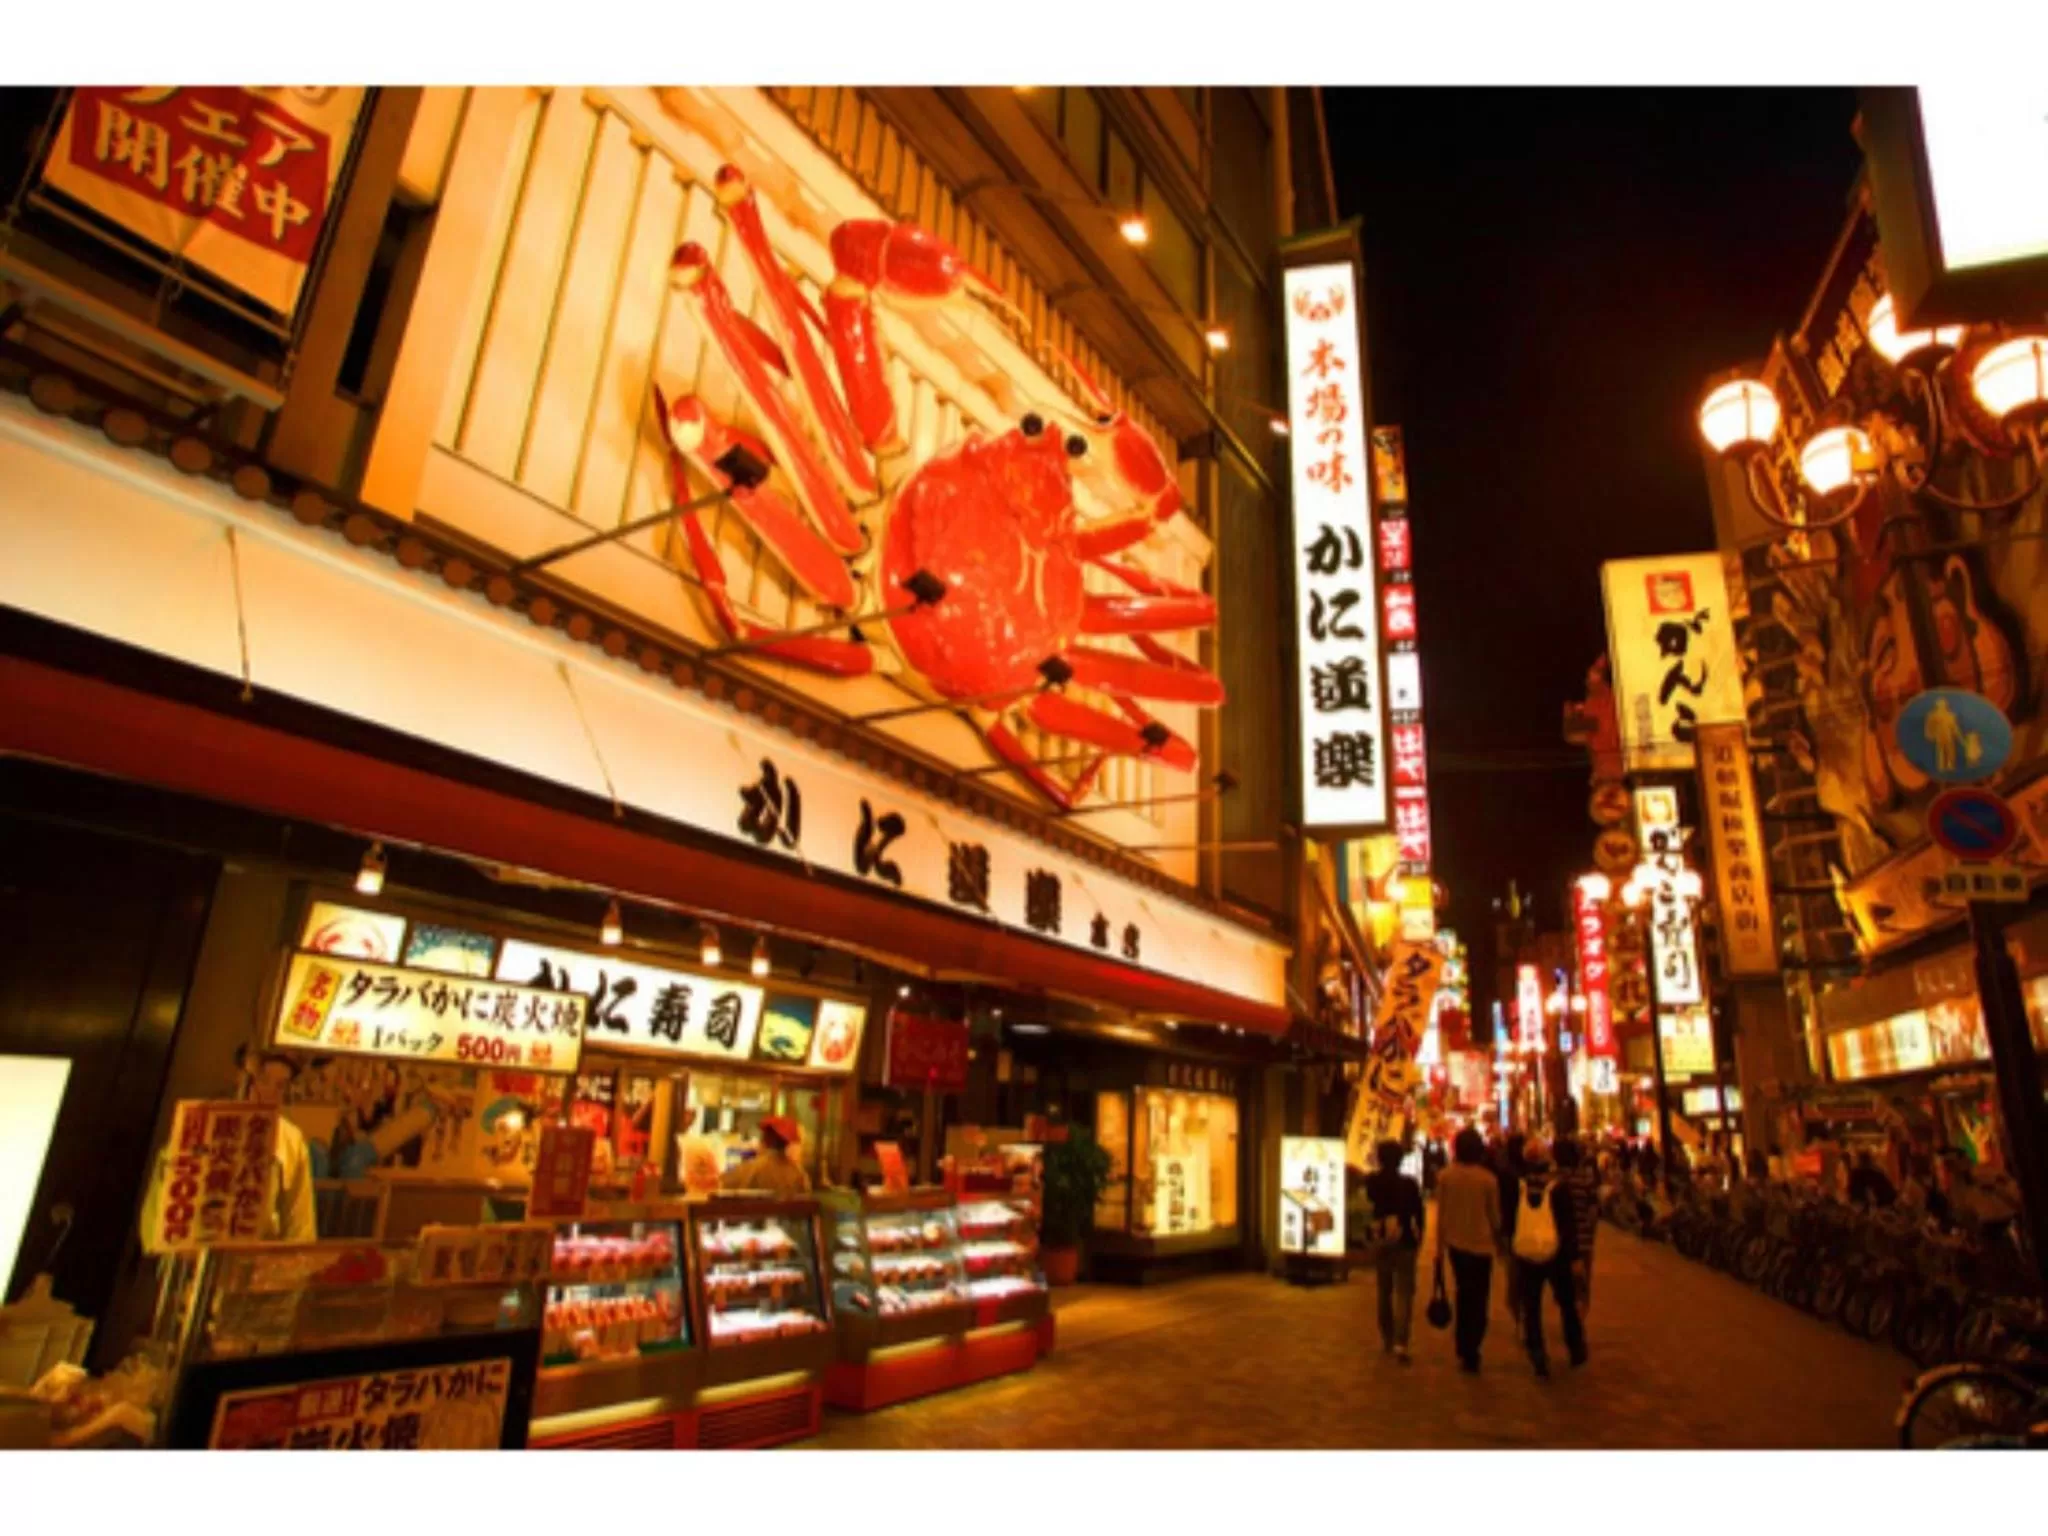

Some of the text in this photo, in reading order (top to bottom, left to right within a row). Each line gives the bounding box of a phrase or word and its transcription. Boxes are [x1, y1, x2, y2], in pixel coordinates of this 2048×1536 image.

[94, 98, 311, 241] 開催中
[1301, 337, 1353, 494] 本場の味
[291, 970, 333, 1032] 名物
[342, 968, 581, 1040] タラバかに炭火焼
[371, 1025, 522, 1064] 1パック 500円
